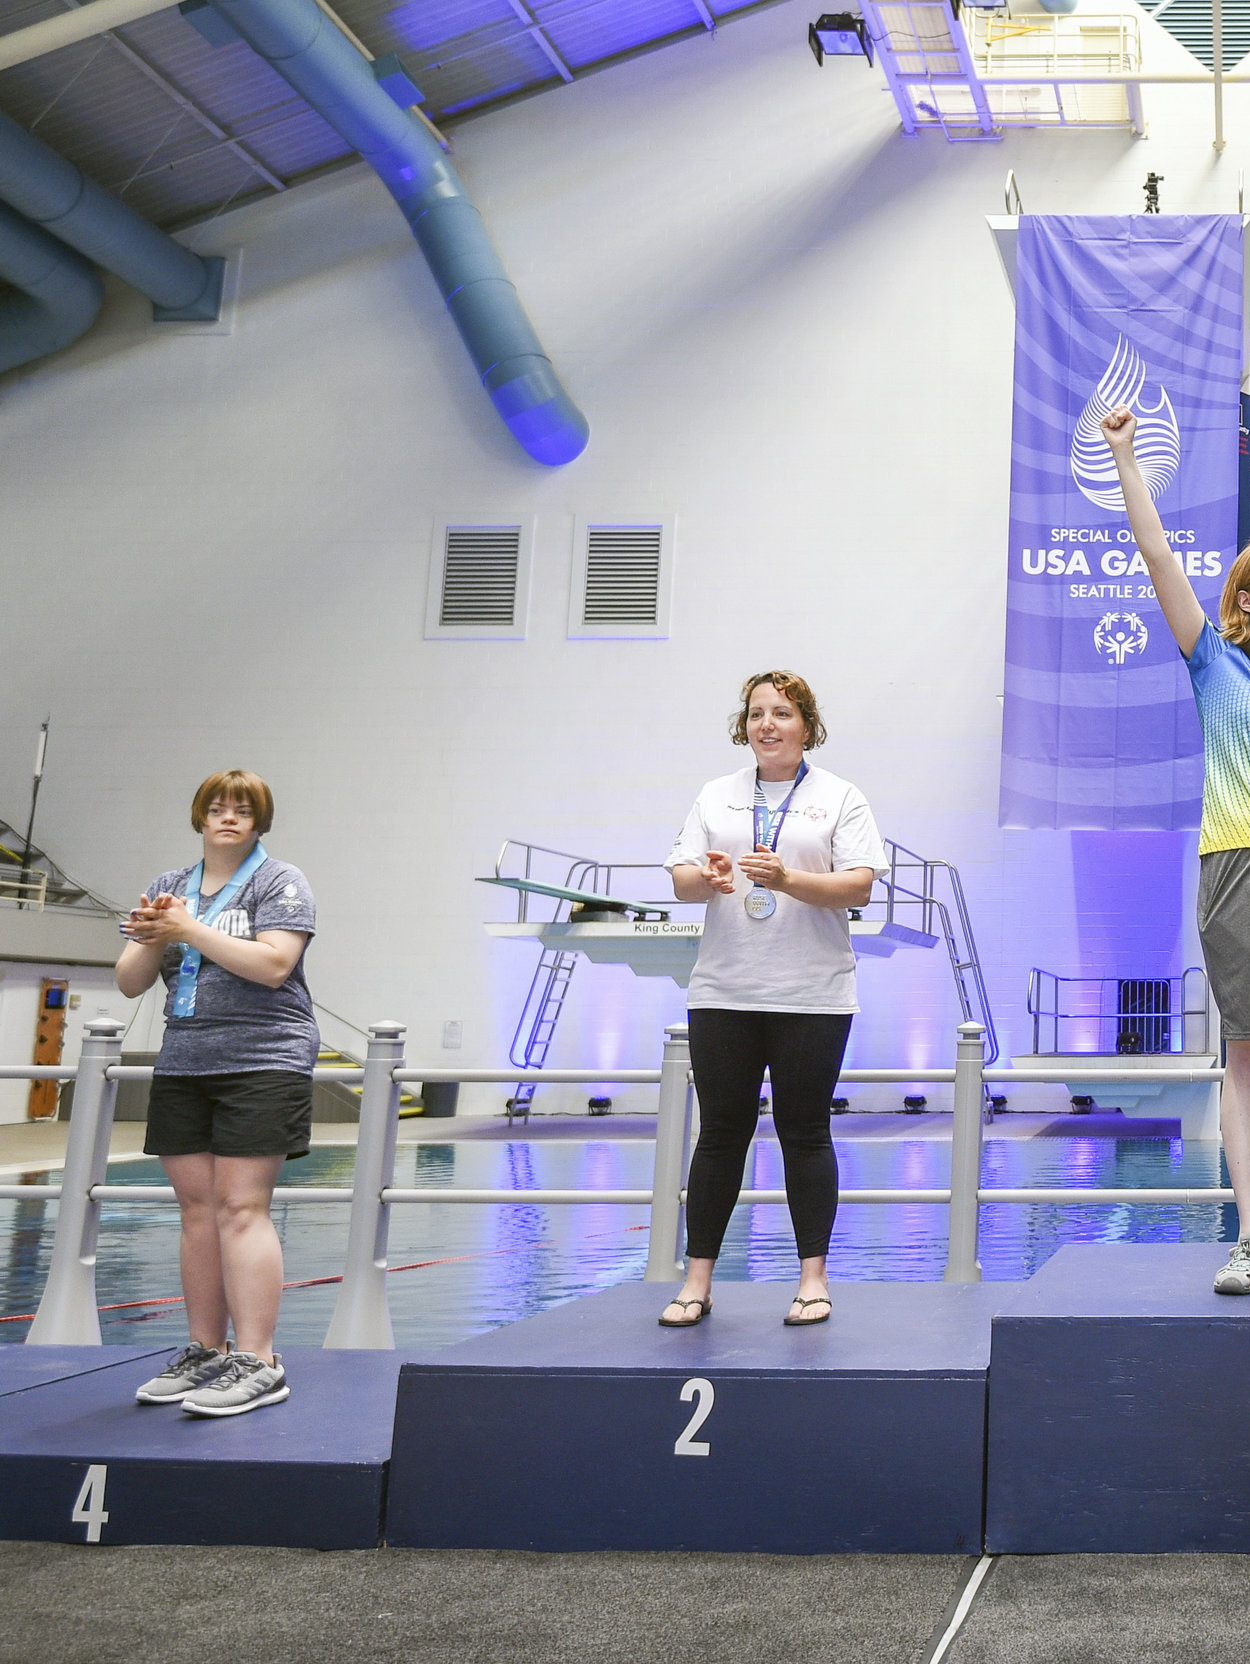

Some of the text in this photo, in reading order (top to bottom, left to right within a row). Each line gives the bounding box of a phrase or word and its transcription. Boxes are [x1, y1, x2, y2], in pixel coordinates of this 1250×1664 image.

[1050, 528, 1195, 544] SPECIAL OLPICS
[1022, 548, 1223, 577] USA GAES
[1069, 584, 1133, 599] SEATTLE
[634, 923, 701, 935] King County
[674, 1377, 715, 1456] 2
[72, 1464, 109, 1542] 4
